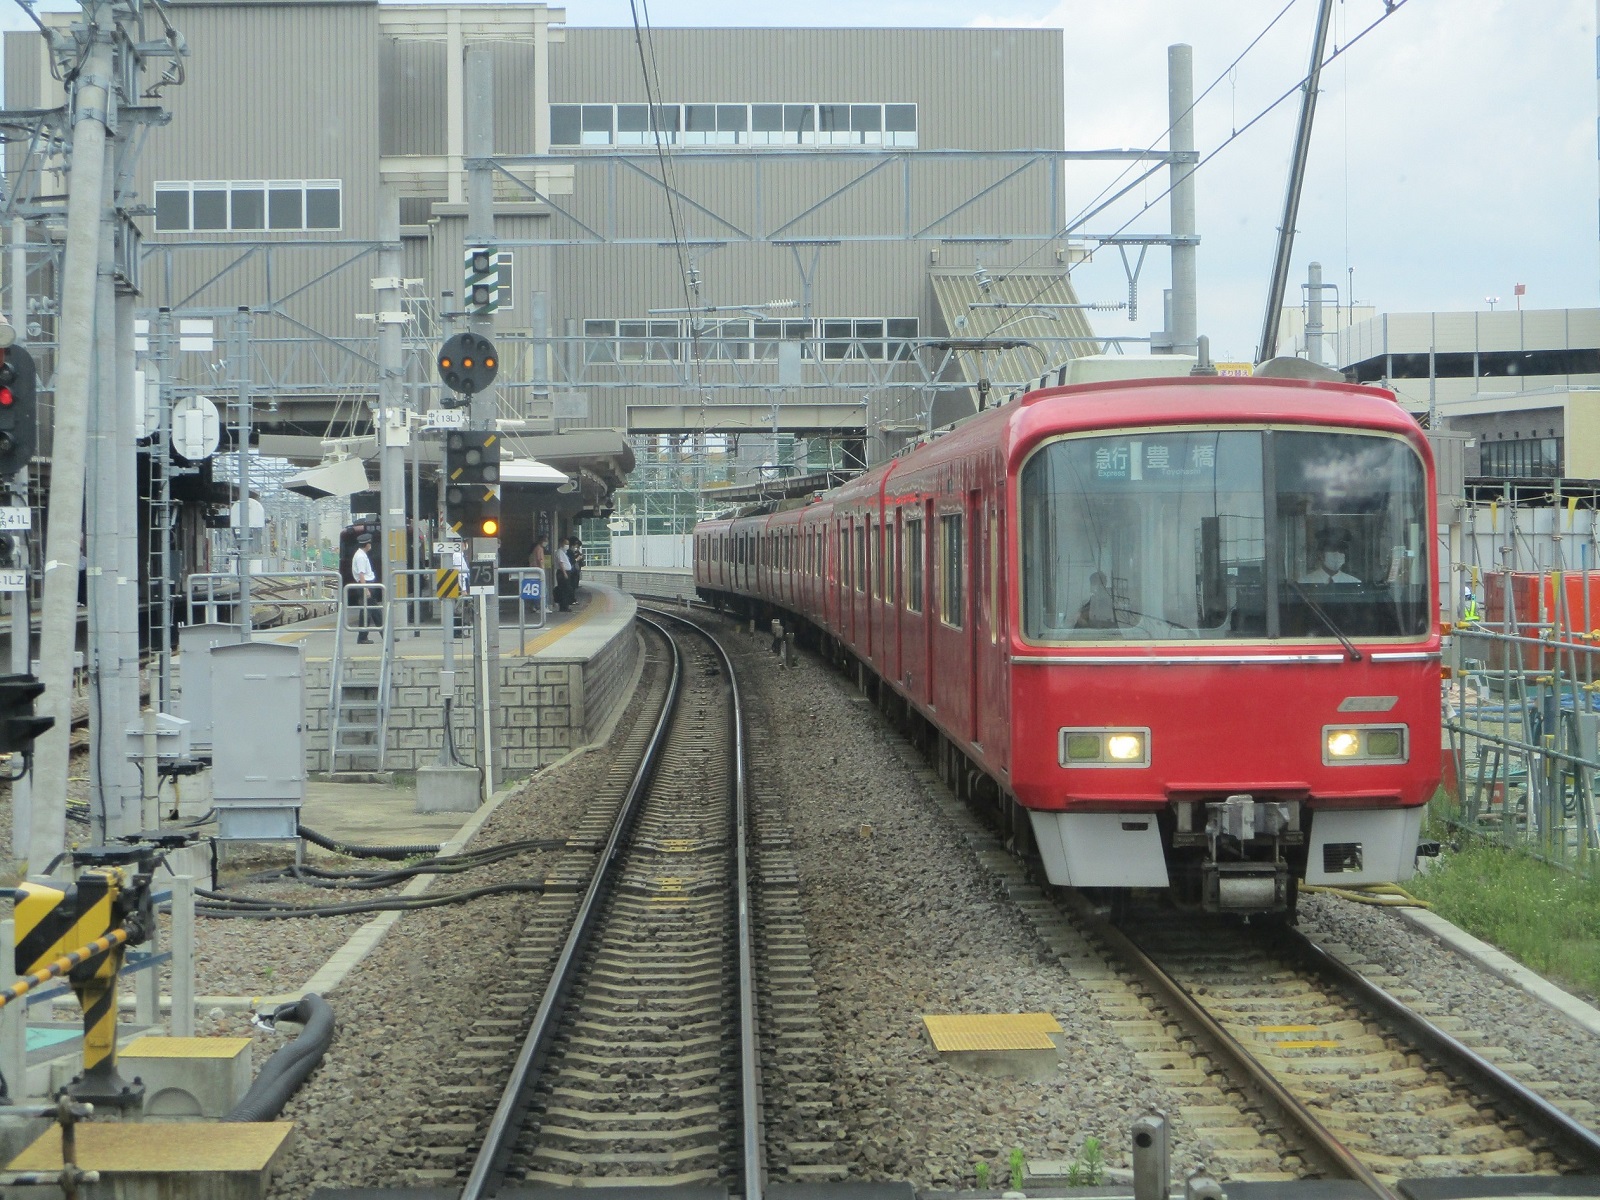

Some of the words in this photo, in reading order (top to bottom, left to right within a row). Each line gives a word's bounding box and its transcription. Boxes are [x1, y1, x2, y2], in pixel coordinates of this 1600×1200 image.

[436, 414, 461, 423] (13L)
[1095, 447, 1128, 470] 急行
[1146, 445, 1215, 469] 豊橋
[1161, 468, 1201, 476] Toyohashi
[8, 514, 29, 525] 41L
[437, 543, 461, 553] 2-3
[471, 565, 492, 583] 75
[0, 575, 24, 585] 1LZ
[522, 583, 540, 596] 46
